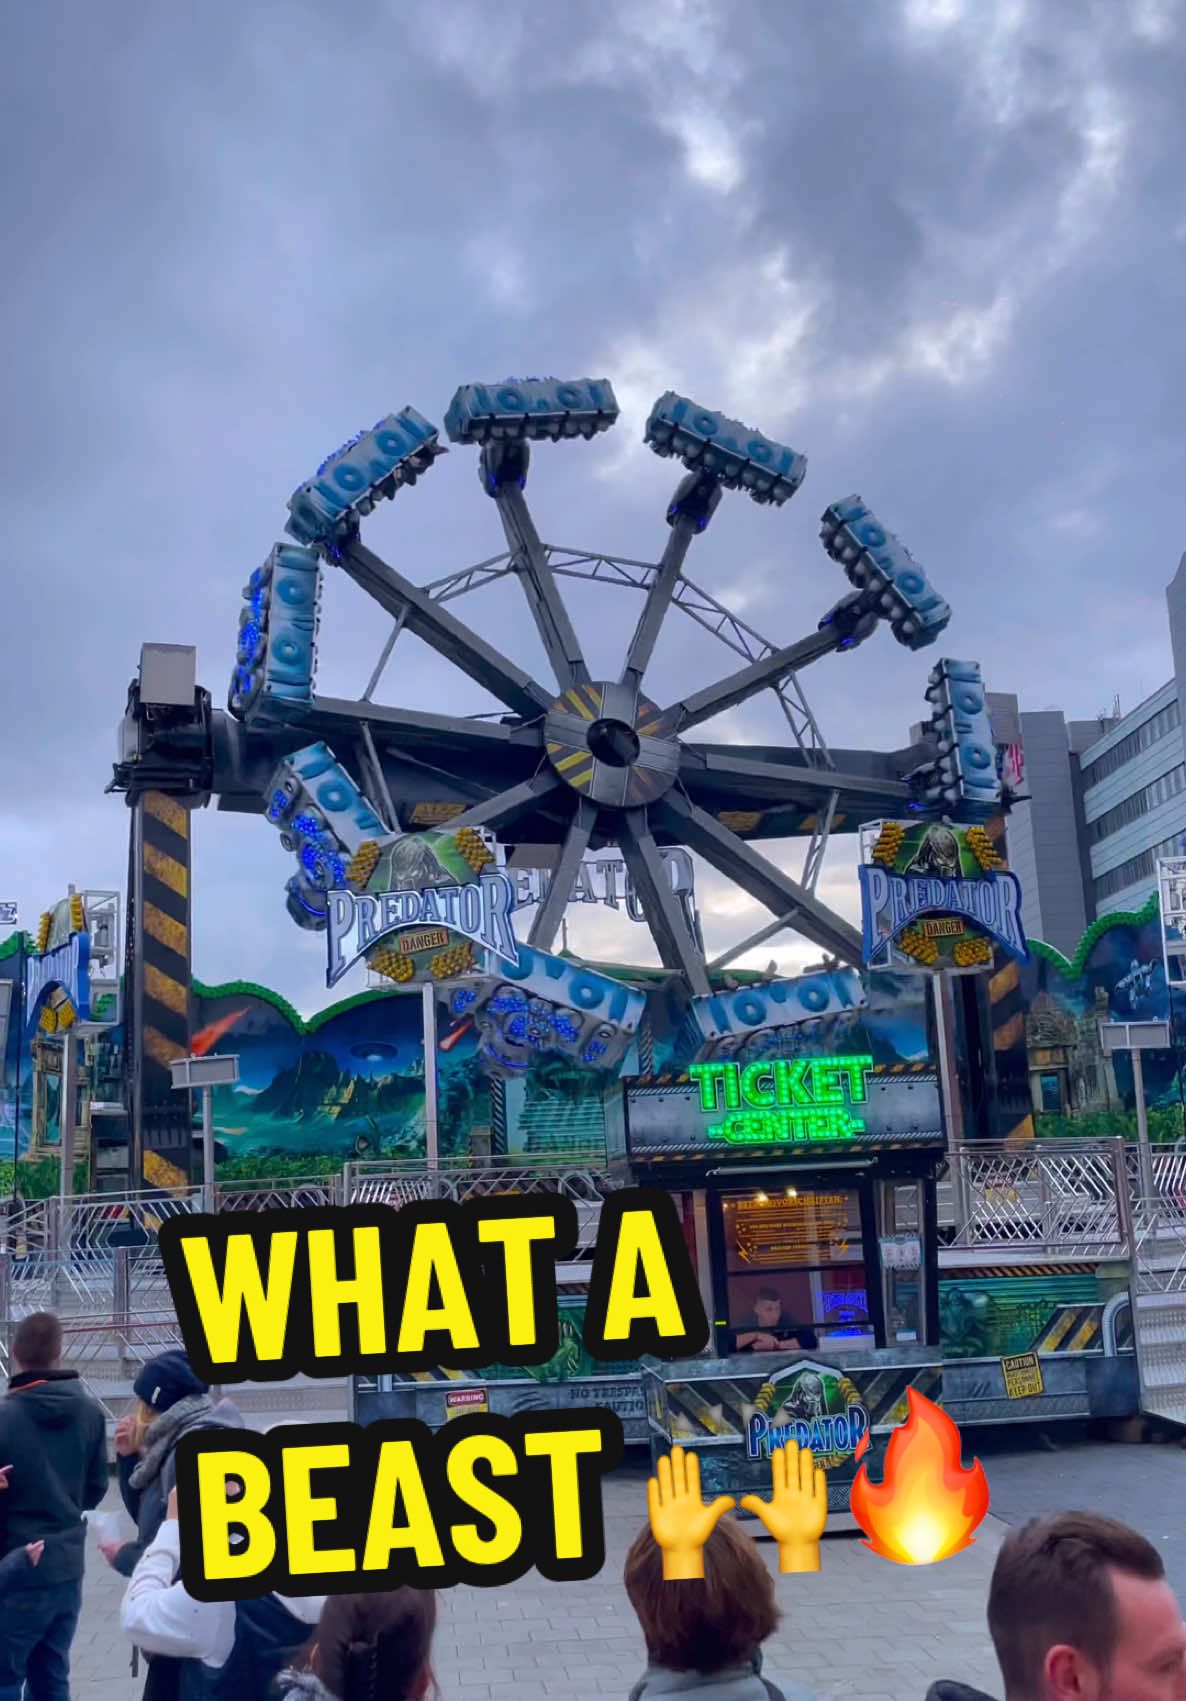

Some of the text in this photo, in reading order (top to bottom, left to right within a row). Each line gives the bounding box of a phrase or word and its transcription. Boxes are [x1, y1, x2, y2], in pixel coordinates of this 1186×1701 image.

[865, 868, 1028, 960] PREDATOR
[327, 873, 518, 987] PREDATOR
[926, 921, 961, 935] DANGER
[403, 931, 445, 952] DANGER
[689, 1055, 874, 1112] TICKET
[722, 1109, 853, 1144] CENTER
[1006, 1355, 1034, 1369] CAUTION
[569, 1388, 590, 1400] NO
[1027, 1382, 1041, 1392] OUT
[448, 1393, 485, 1403] WARNING
